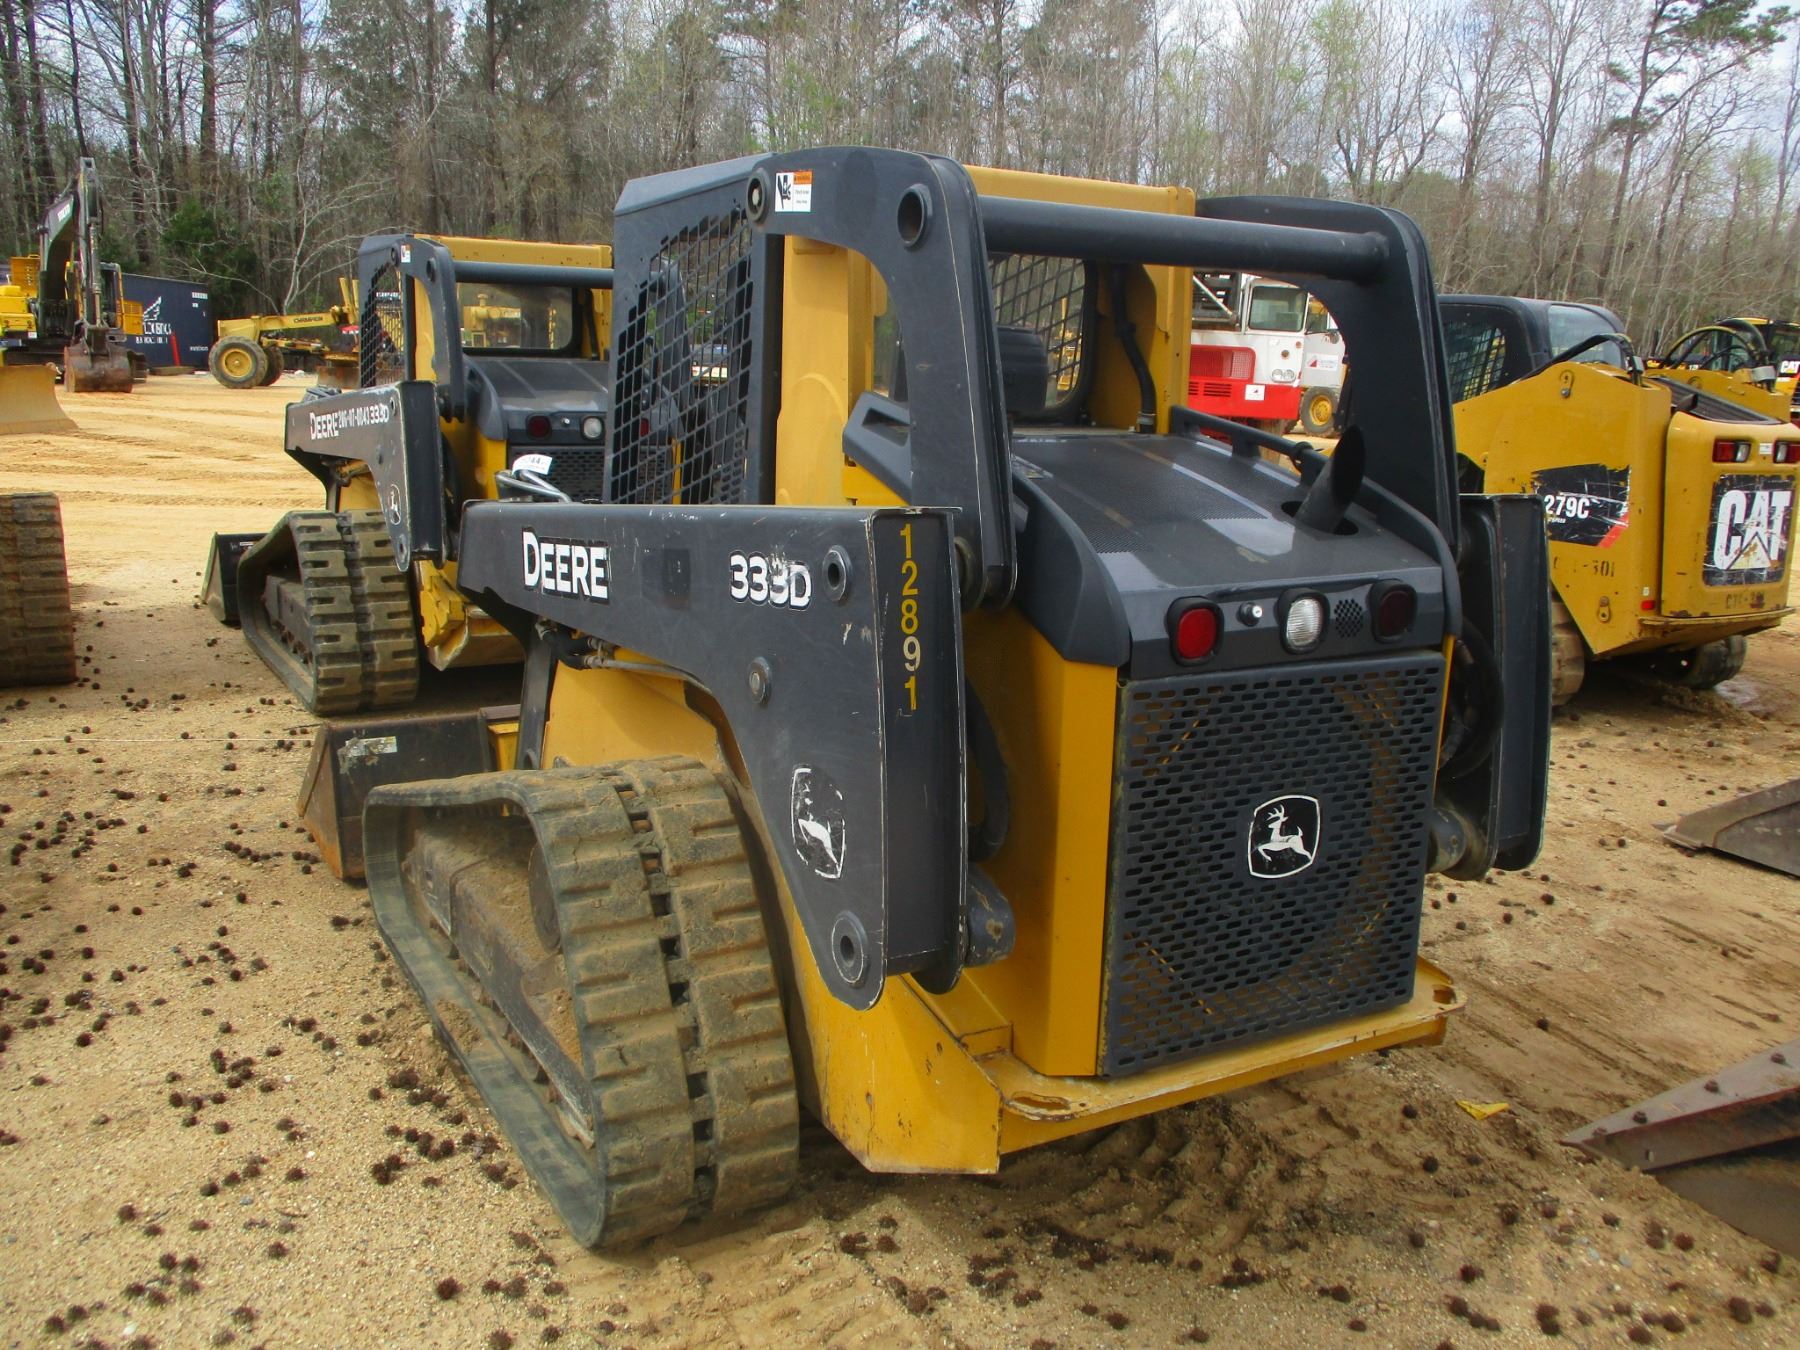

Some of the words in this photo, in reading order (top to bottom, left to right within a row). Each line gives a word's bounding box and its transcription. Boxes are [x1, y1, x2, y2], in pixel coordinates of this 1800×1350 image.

[1780, 360, 1800, 374] CAT
[309, 411, 339, 441] DEERE
[1544, 494, 1590, 519] 279C
[1713, 489, 1792, 570] CAT
[522, 526, 610, 601] DEERE
[729, 554, 813, 608] 333D
[899, 522, 922, 712] 12891
